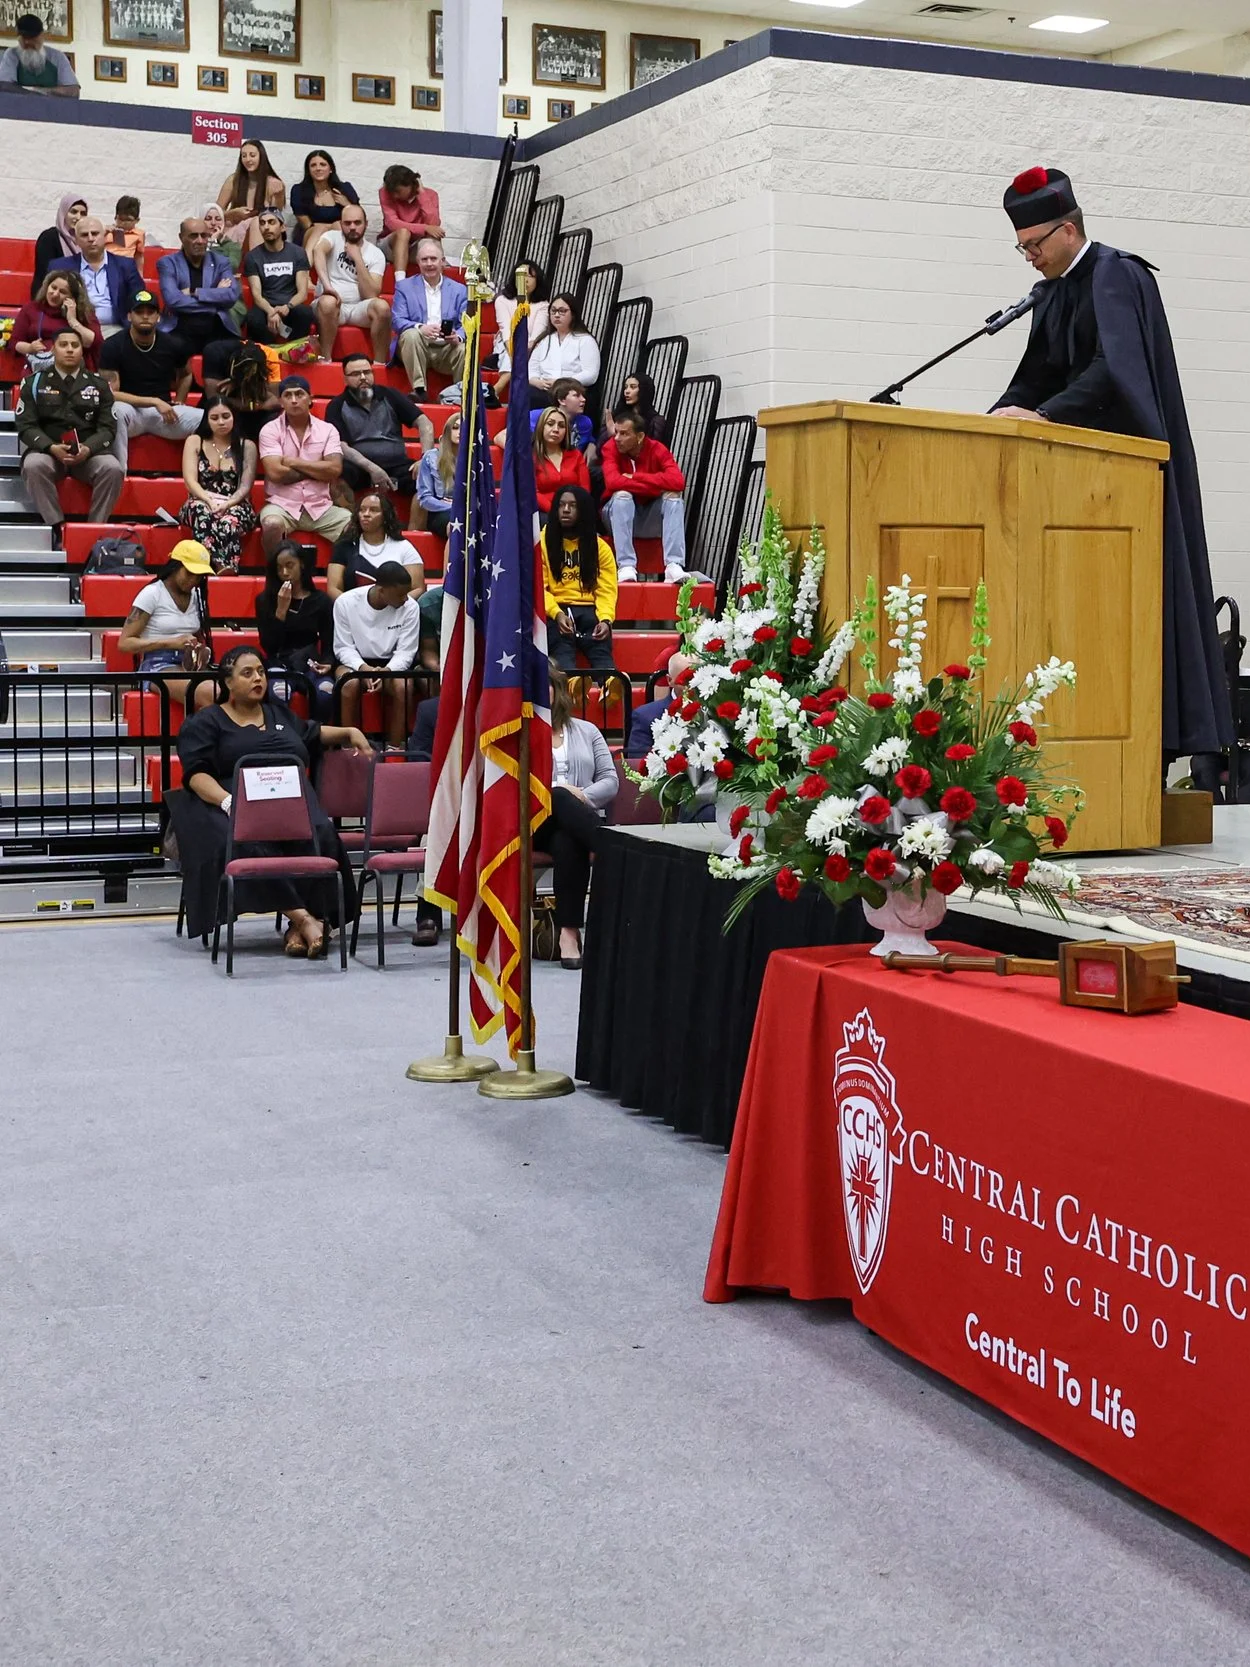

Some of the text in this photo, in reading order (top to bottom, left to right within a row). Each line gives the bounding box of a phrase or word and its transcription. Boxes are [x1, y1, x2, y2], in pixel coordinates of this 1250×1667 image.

[195, 115, 239, 130] Section
[206, 131, 228, 144] 305
[843, 1104, 881, 1149] CCHS
[908, 1130, 1248, 1321] CENTRAL CATHOLIC
[942, 1213, 1197, 1365] HIGH SCHOOL
[965, 1312, 1136, 1439] Central To Life
